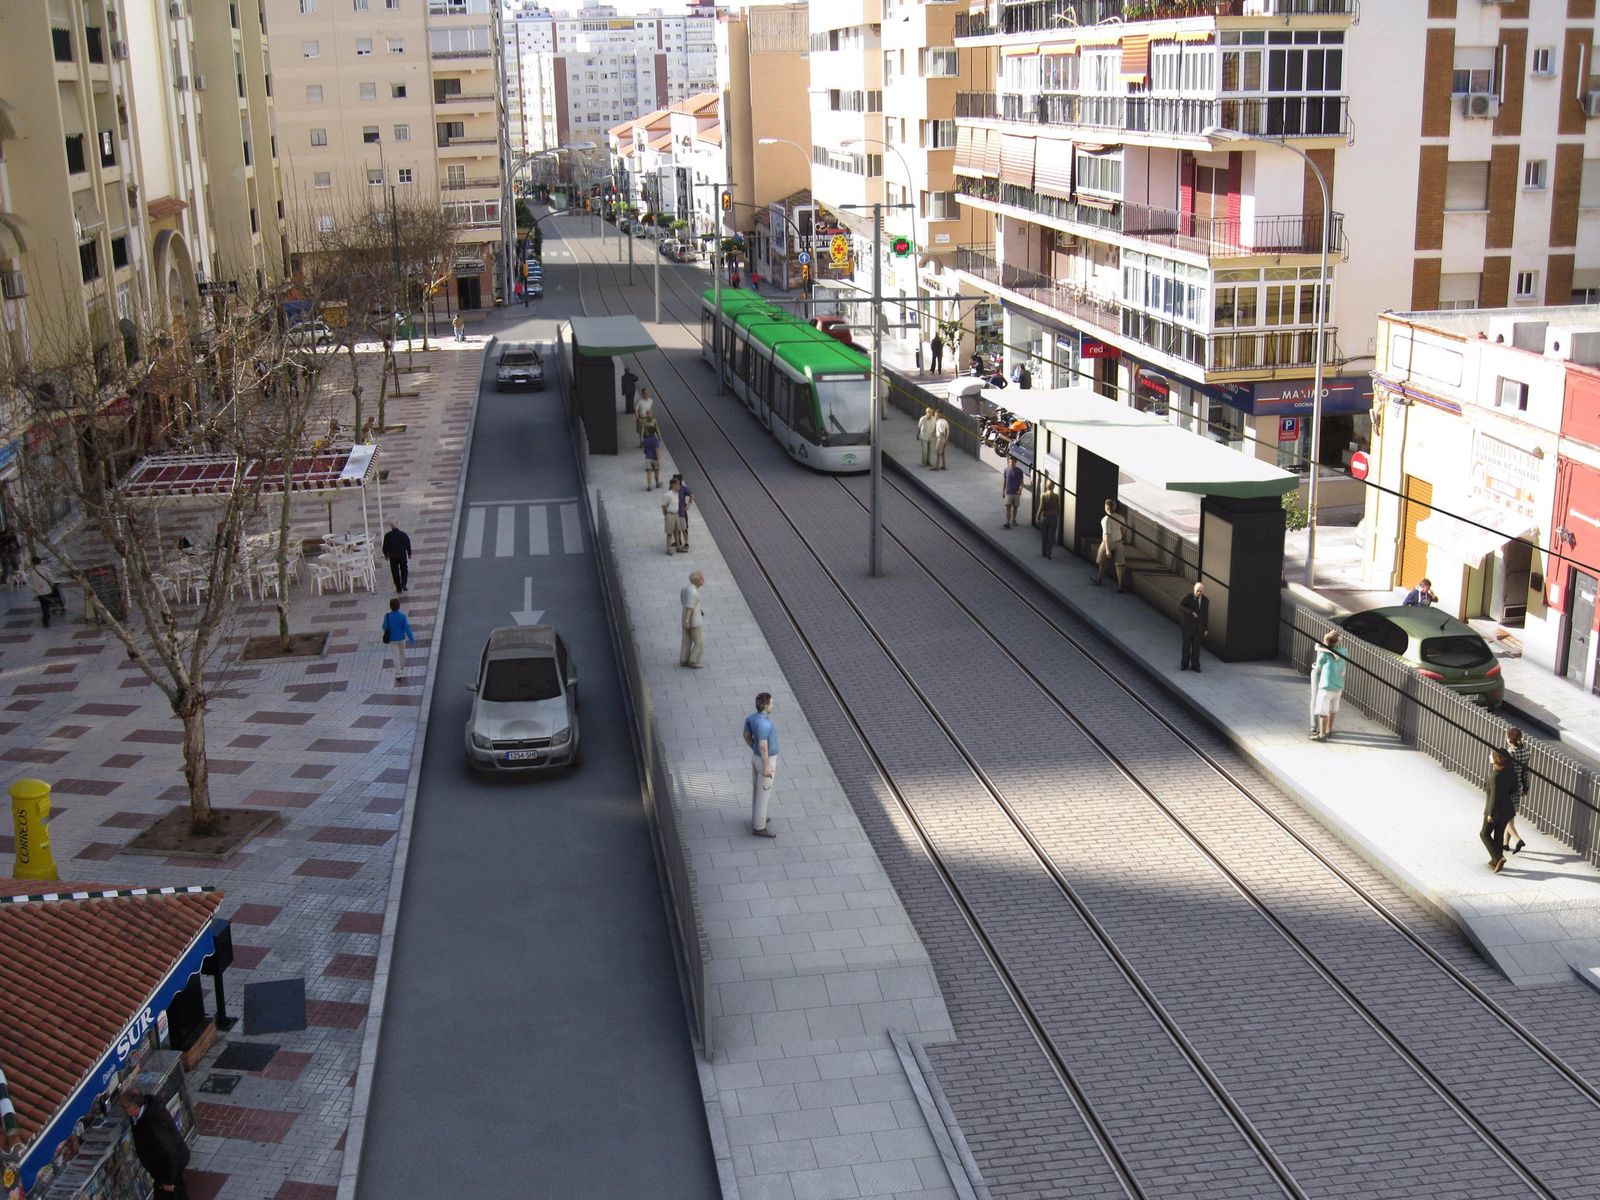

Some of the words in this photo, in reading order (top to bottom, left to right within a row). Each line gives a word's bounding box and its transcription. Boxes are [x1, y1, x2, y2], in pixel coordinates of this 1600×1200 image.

[1089, 345, 1104, 354] red
[1285, 419, 1293, 430] P
[18, 808, 29, 864] CORREOS
[117, 1006, 155, 1062] SUR
